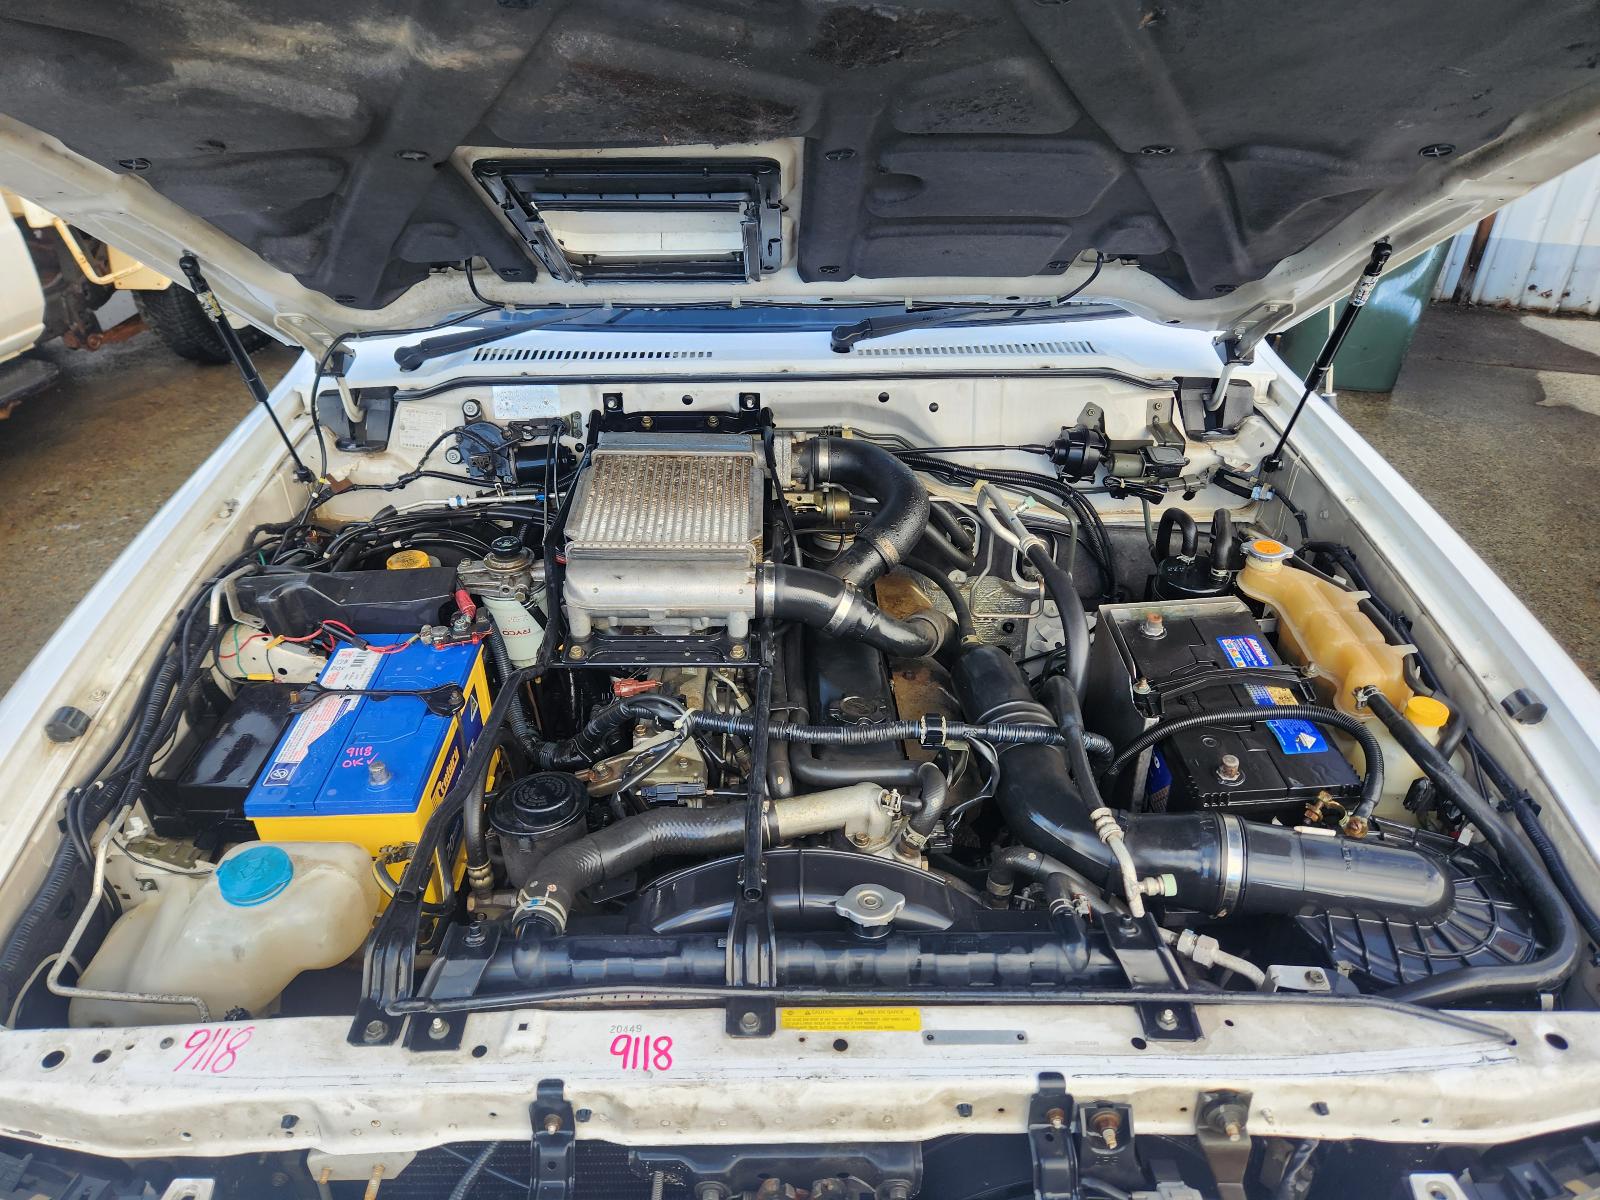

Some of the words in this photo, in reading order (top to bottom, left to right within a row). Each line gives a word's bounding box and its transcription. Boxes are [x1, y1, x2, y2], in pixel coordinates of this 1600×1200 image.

[502, 628, 531, 636] RYCO
[342, 757, 364, 769] OK
[346, 745, 373, 758] 9118
[437, 745, 460, 797] Century
[173, 1026, 256, 1073] 9118
[610, 1034, 673, 1073] 9118
